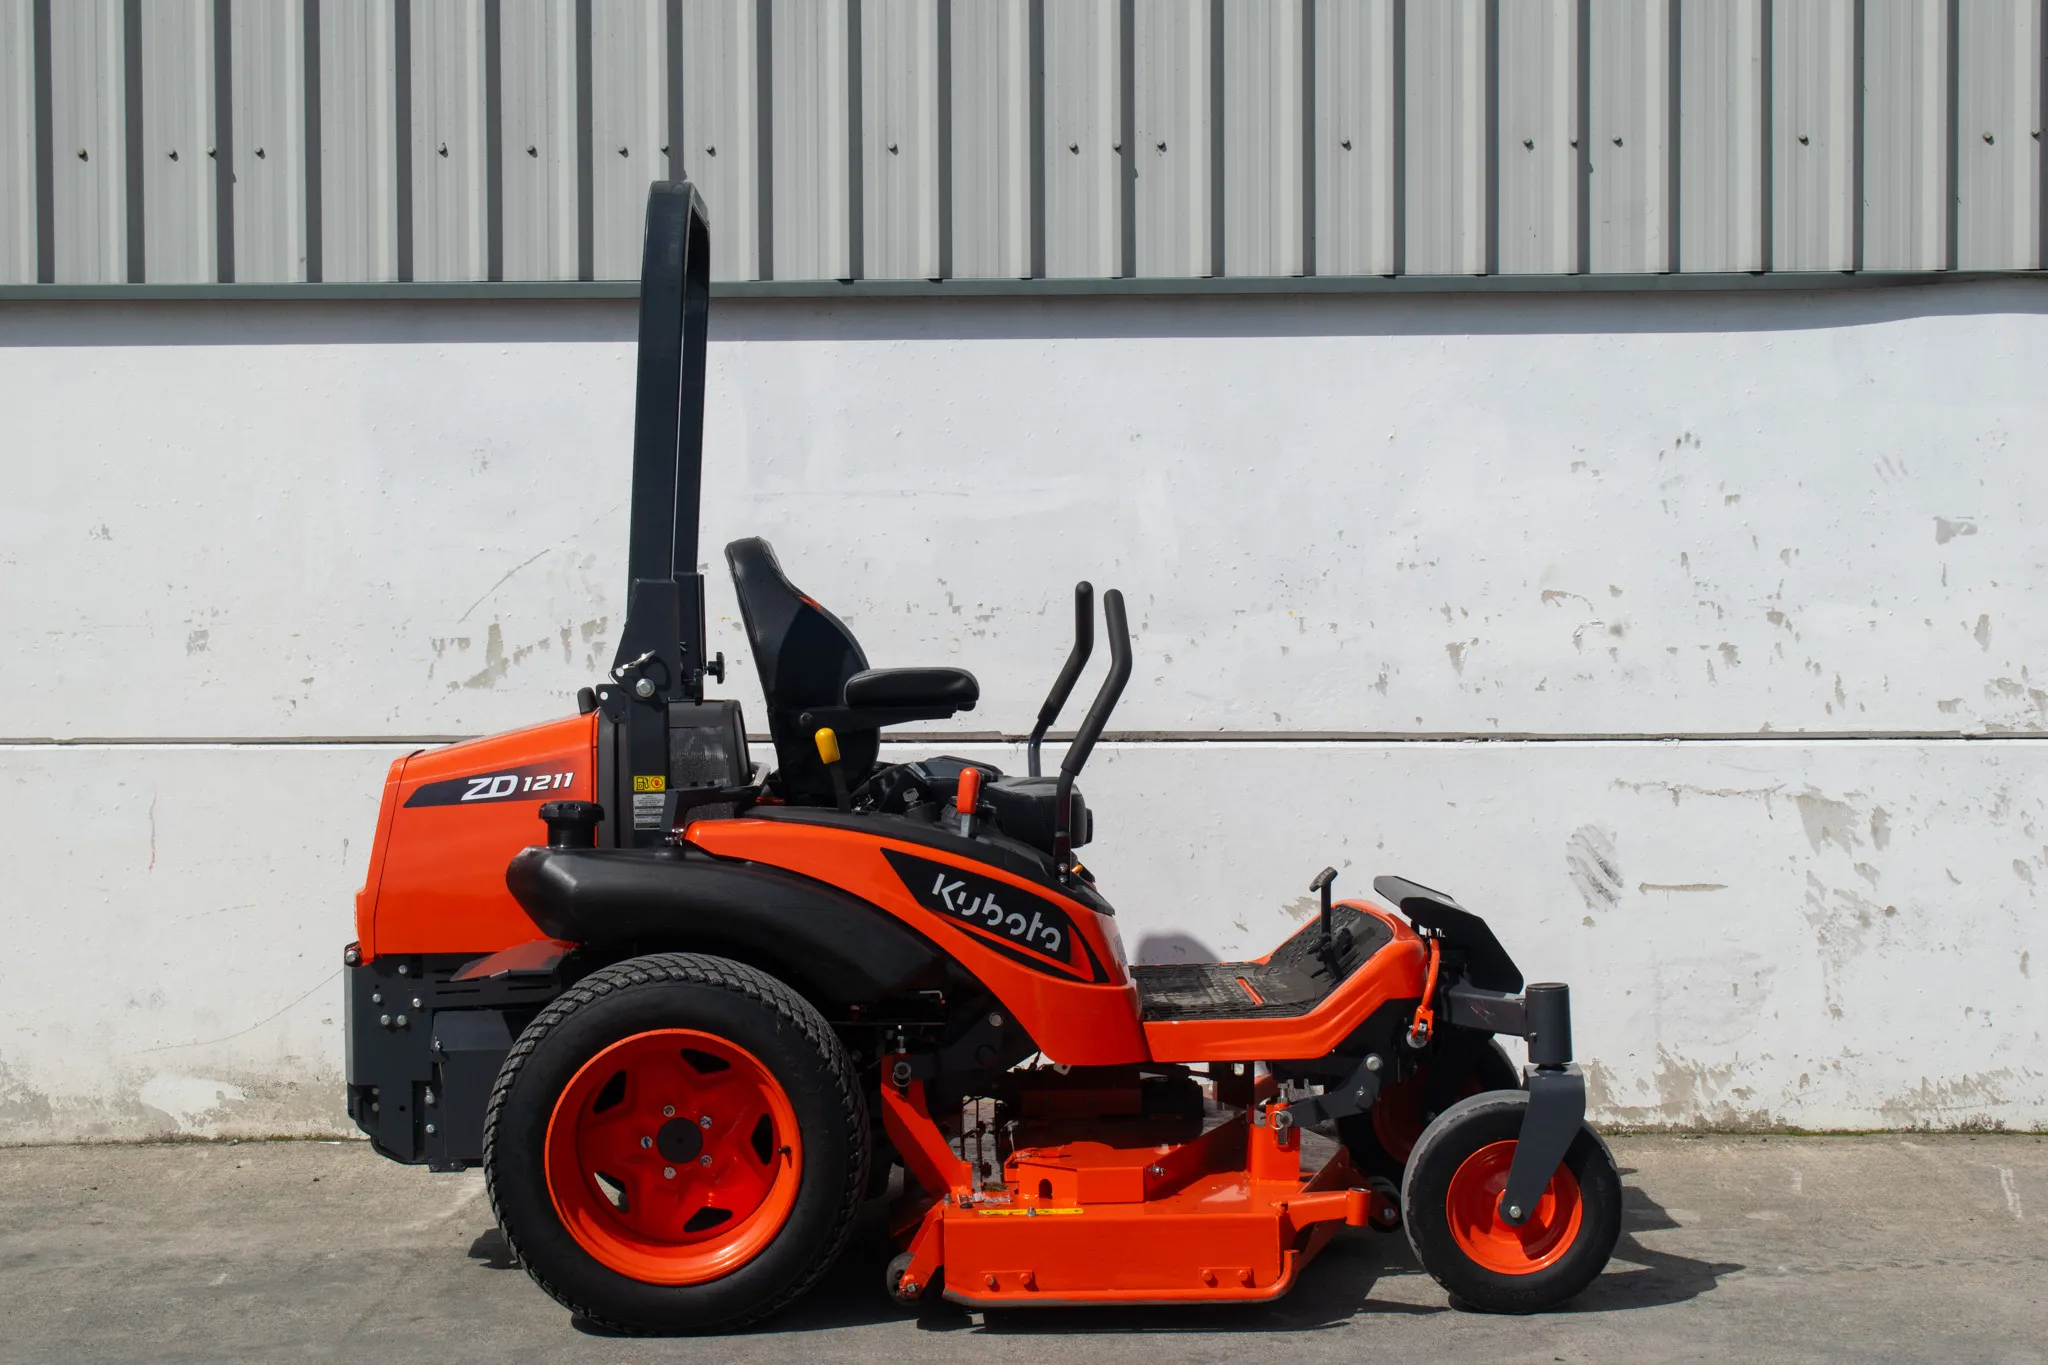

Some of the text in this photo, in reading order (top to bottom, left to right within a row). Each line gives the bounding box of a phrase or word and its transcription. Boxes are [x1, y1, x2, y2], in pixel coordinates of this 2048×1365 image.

[461, 772, 574, 801] ZD 1211
[932, 873, 1061, 952] Kubota
